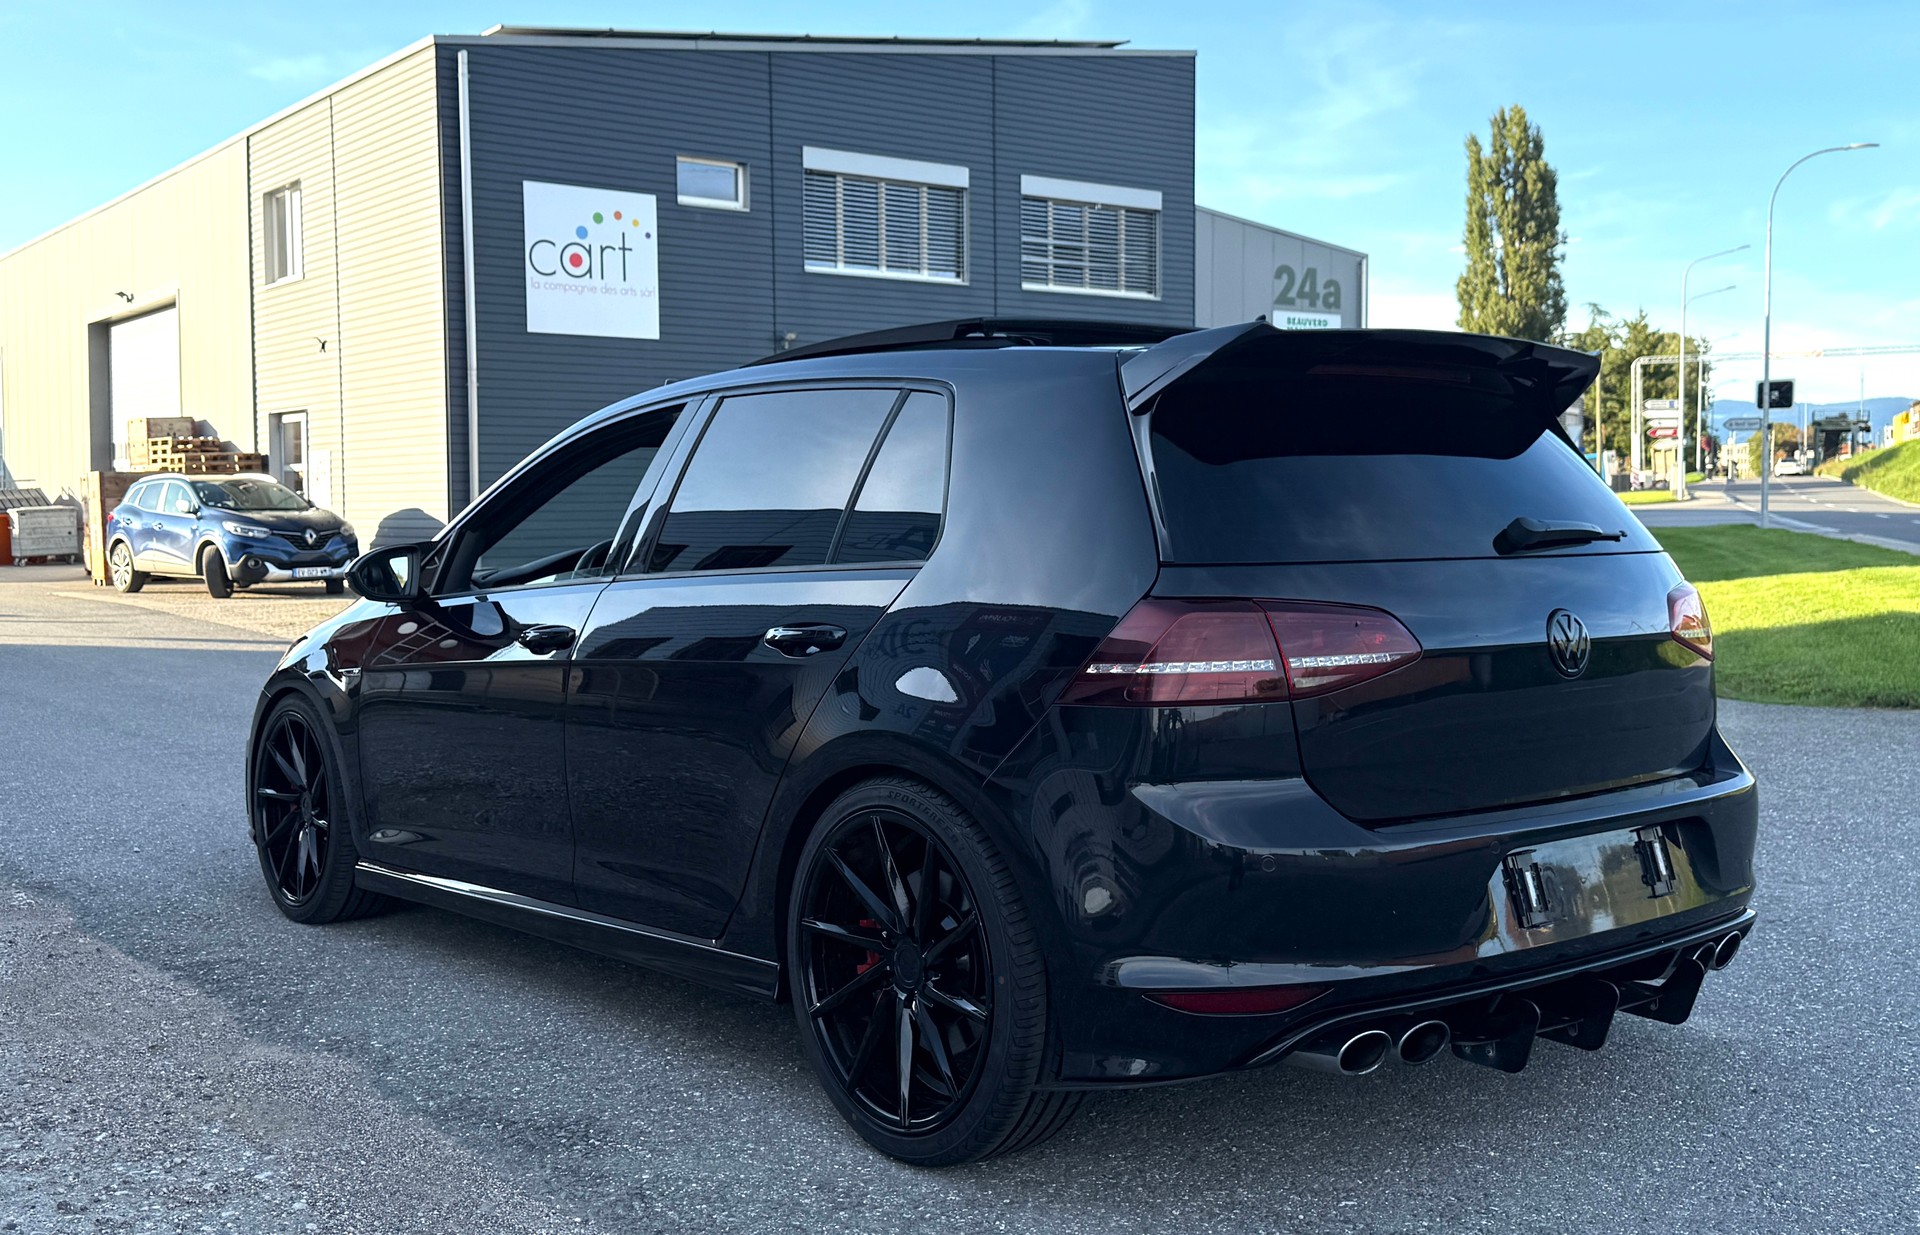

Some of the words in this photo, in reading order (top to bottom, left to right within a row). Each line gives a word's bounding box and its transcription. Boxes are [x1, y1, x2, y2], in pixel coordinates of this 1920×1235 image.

[530, 277, 540, 290] la
[543, 281, 597, 295] compagnie
[600, 283, 617, 296] des
[620, 286, 637, 297] arts
[1273, 264, 1341, 310] 24a
[1287, 316, 1329, 327] BEAUVERD
